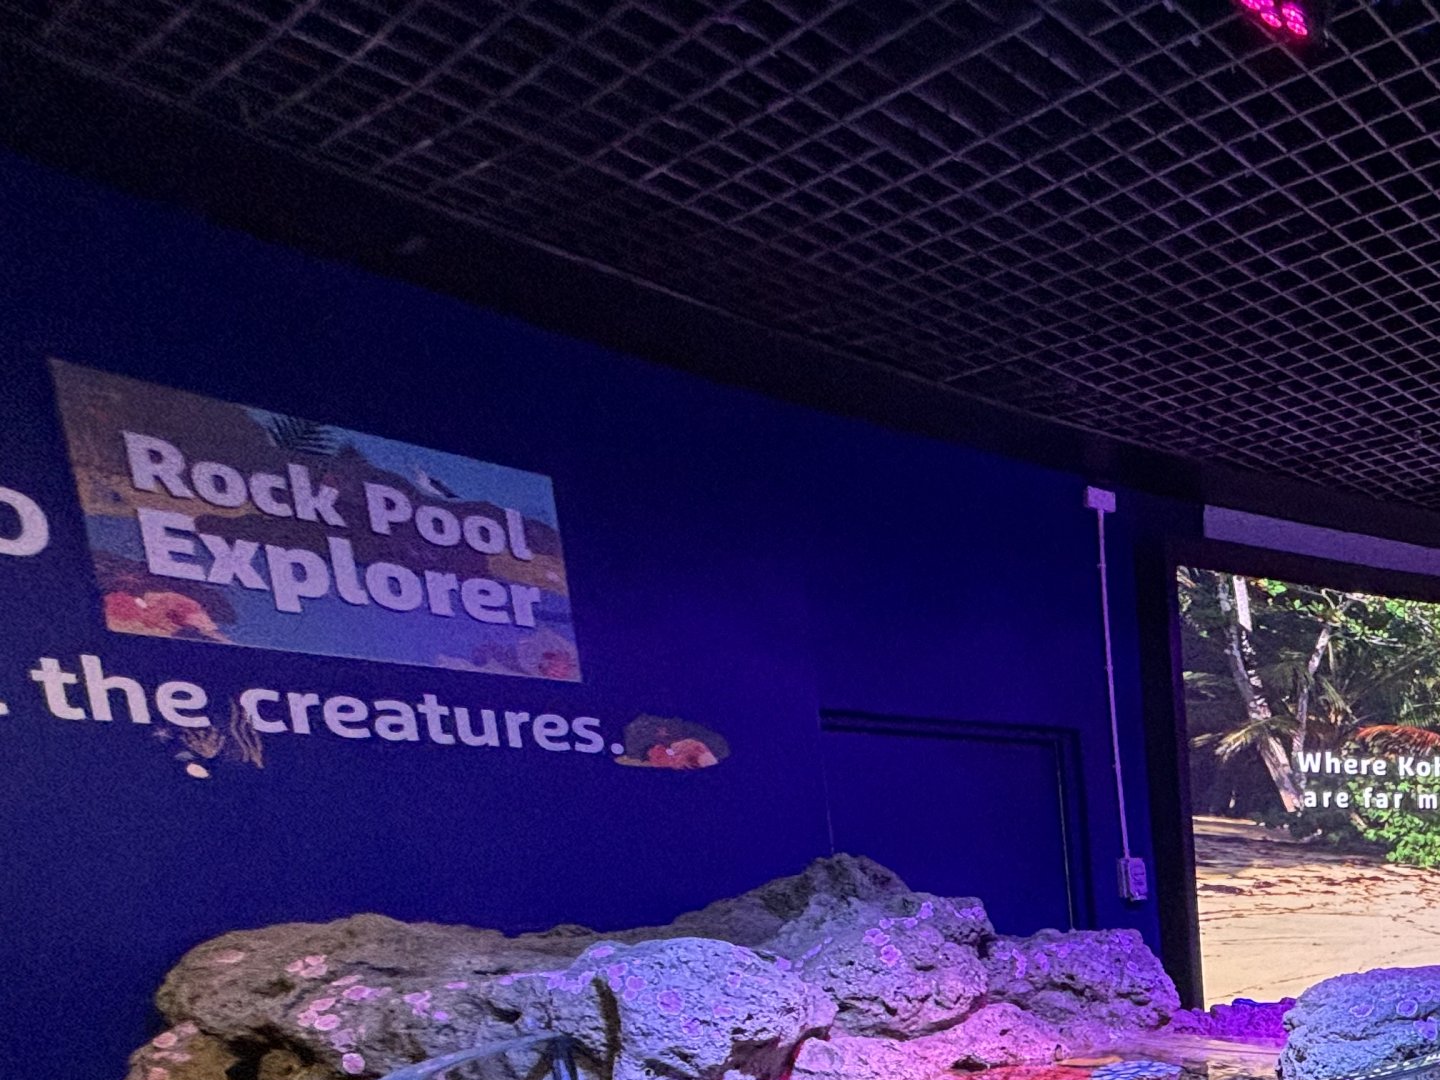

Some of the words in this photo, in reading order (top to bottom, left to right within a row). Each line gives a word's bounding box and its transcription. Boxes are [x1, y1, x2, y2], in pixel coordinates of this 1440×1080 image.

[121, 430, 347, 528] Rock
[361, 480, 534, 562] Pool
[136, 508, 541, 628] Explorer
[30, 653, 211, 728] the
[240, 686, 625, 756] creatures.
[1297, 751, 1387, 776] Where
[1304, 789, 1350, 809] are
[1362, 787, 1404, 810] far
